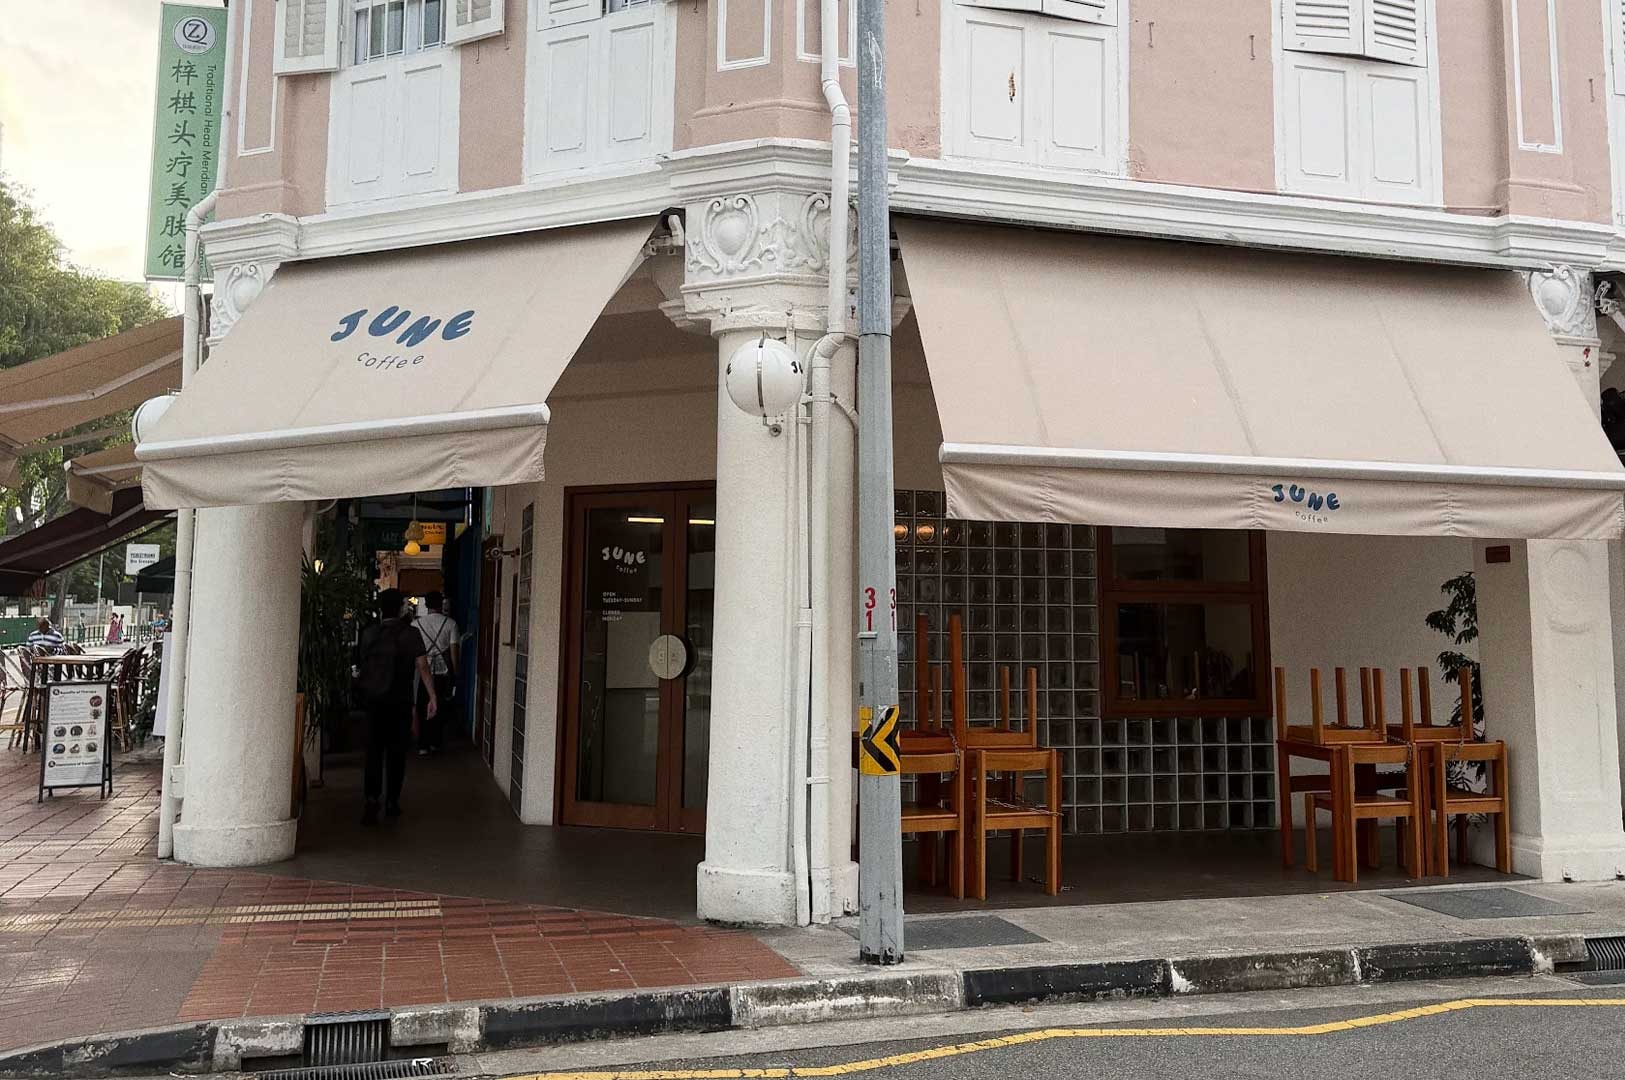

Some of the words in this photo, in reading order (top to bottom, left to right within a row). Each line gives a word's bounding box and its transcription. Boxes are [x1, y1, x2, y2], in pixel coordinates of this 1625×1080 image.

[204, 64, 217, 117] Traditional
[202, 119, 214, 148] Head
[200, 150, 212, 196] Meridian
[330, 305, 476, 348] JUNE
[1272, 484, 1340, 511] JUNE
[602, 546, 646, 565] JUNE
